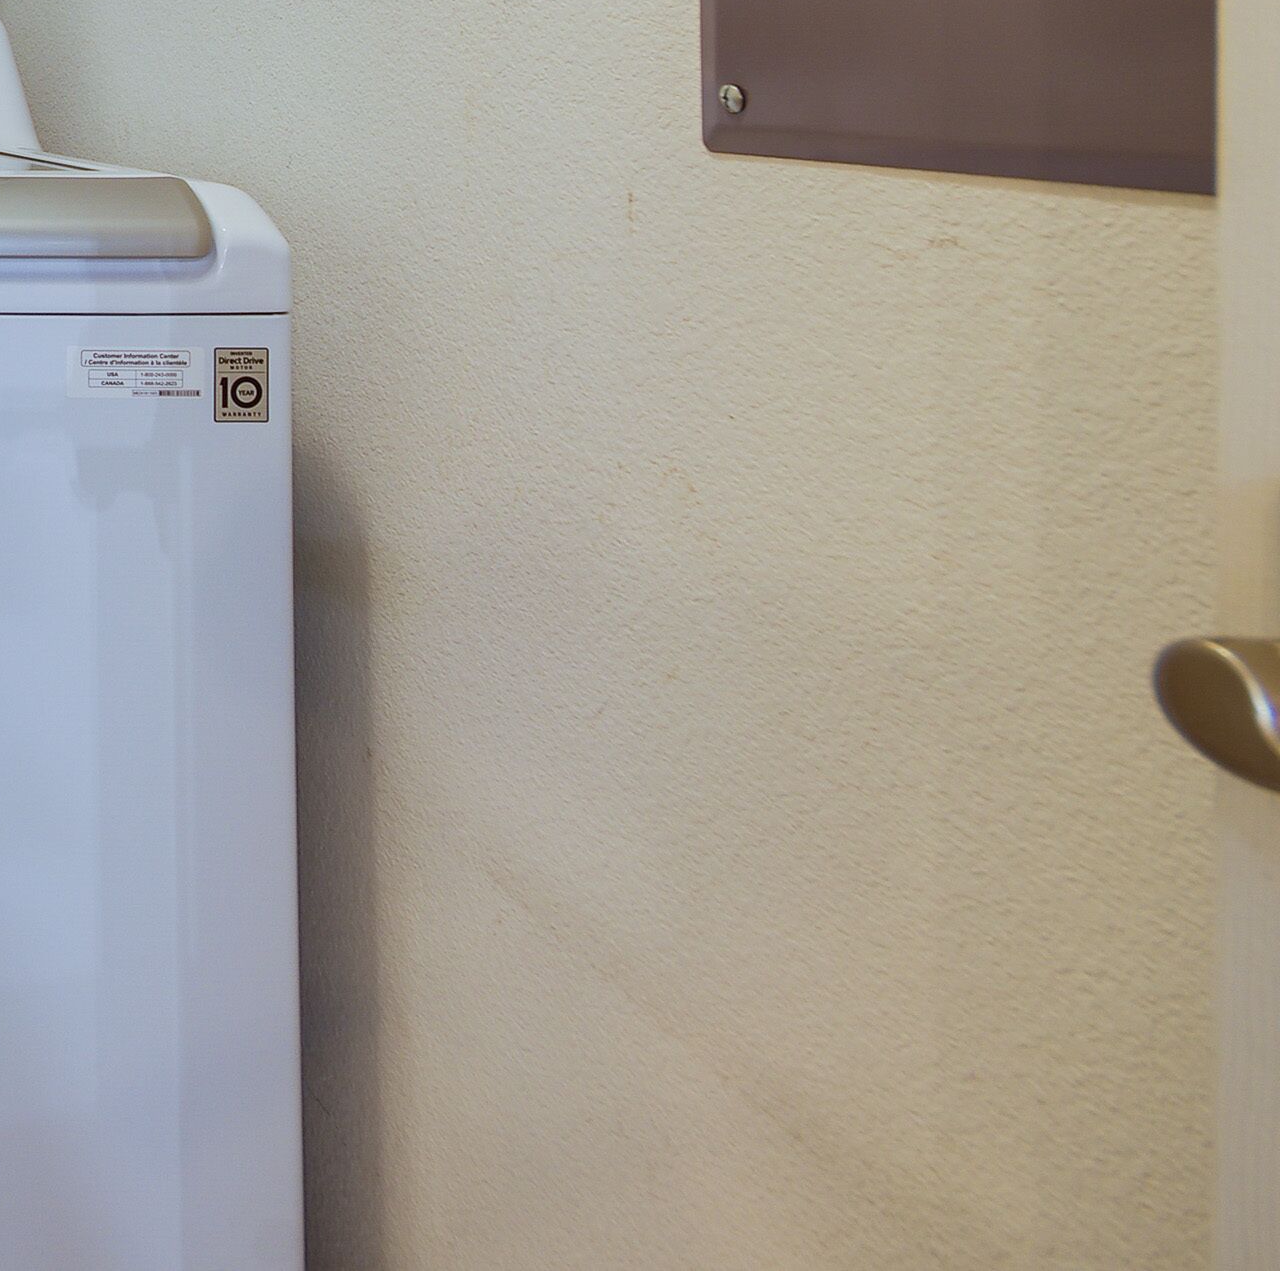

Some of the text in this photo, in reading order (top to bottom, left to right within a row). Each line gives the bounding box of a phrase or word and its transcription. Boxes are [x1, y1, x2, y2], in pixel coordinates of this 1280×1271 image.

[218, 357, 265, 365] Direct Drive
[219, 376, 263, 409] 10
